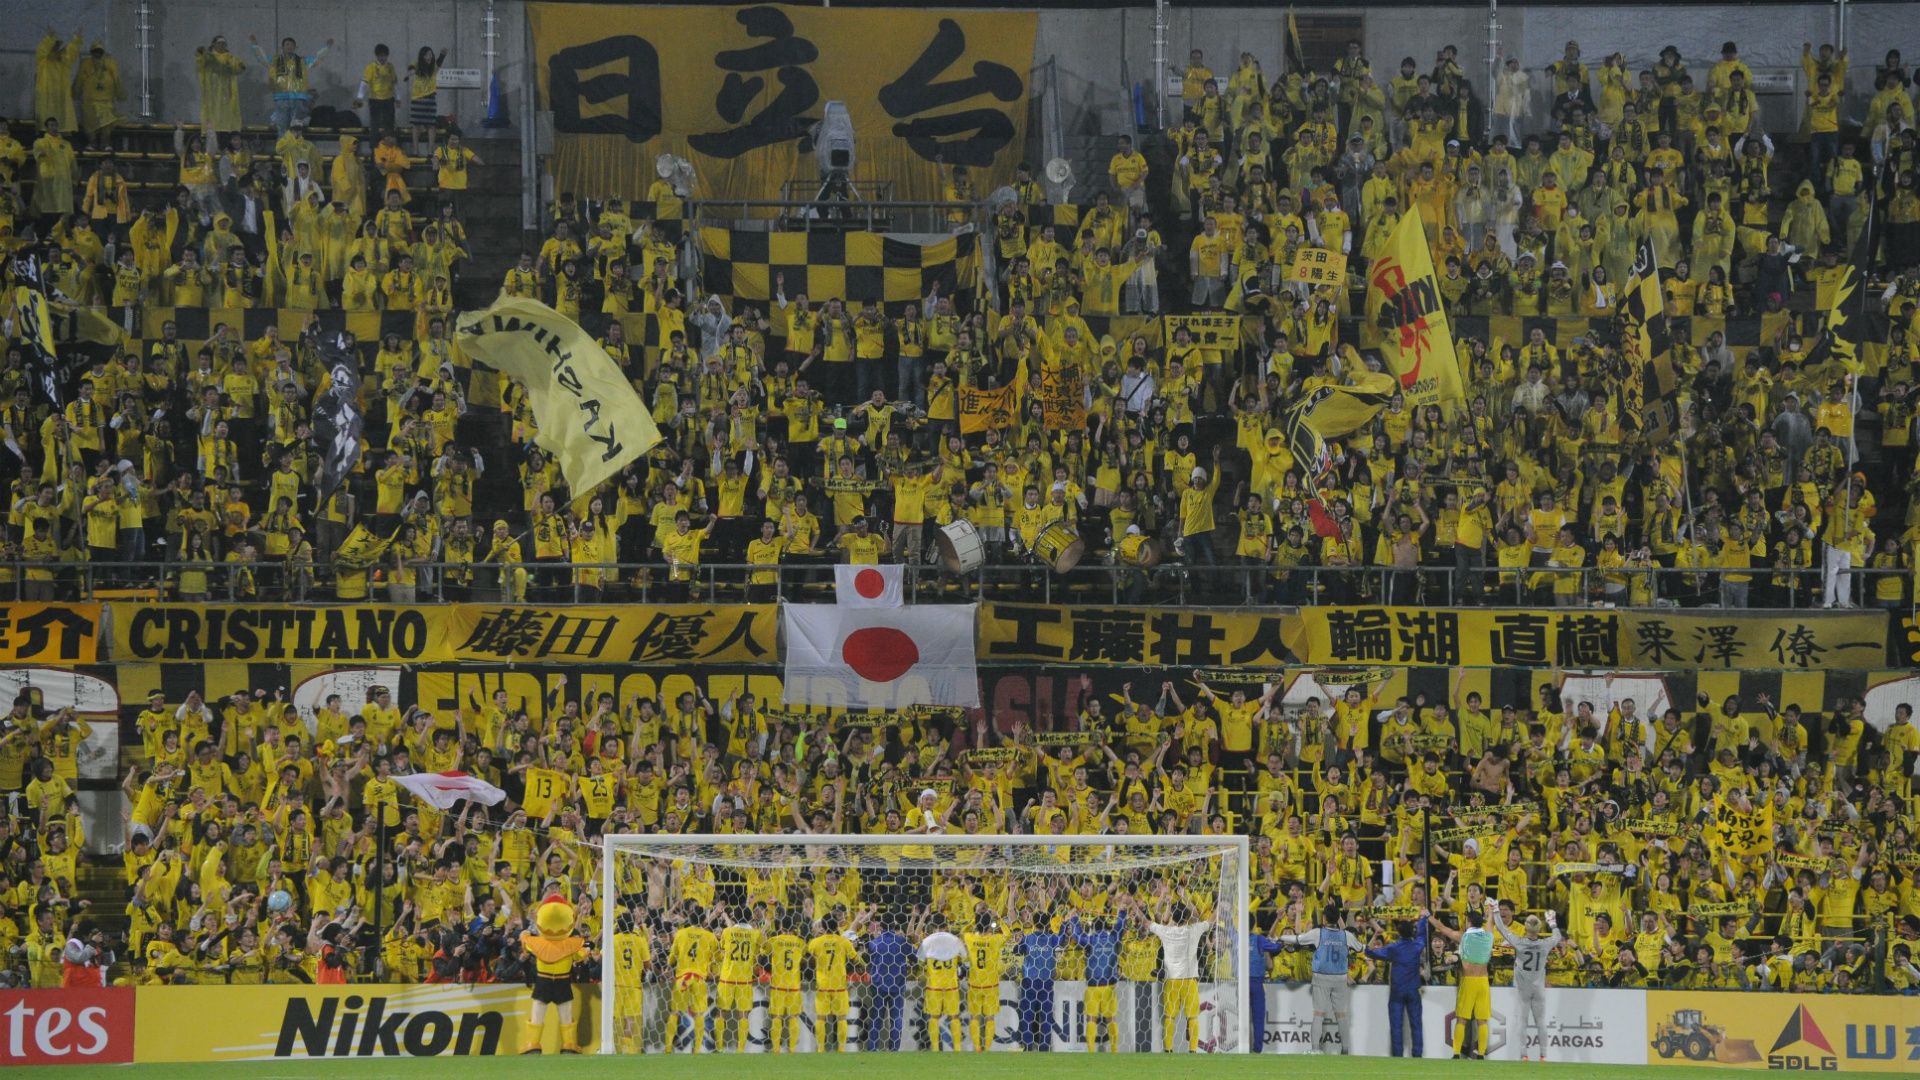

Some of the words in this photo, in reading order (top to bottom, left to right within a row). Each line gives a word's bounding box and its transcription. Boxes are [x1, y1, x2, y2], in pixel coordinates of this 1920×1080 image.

[549, 6, 1023, 167] 日立台
[129, 607, 428, 660] CRISTIANO
[990, 606, 1295, 665] 工藤壮人
[1327, 609, 1618, 666] 輪湖直樹
[1637, 619, 1883, 668] 栗澤僚一
[535, 777, 552, 799] 13
[589, 778, 608, 798] 25
[1717, 804, 1765, 829] 柏から
[623, 948, 633, 970] 9
[687, 942, 698, 962] 4
[730, 941, 750, 961] 20
[784, 950, 794, 971] 6
[825, 949, 835, 971] 7
[976, 949, 986, 969] 8
[1522, 951, 1540, 972] 21
[2, 998, 109, 1057] tes
[274, 995, 503, 1057] Nikon
[1262, 1031, 1343, 1044] QATARAS
[1768, 1055, 1838, 1071] SDLG
